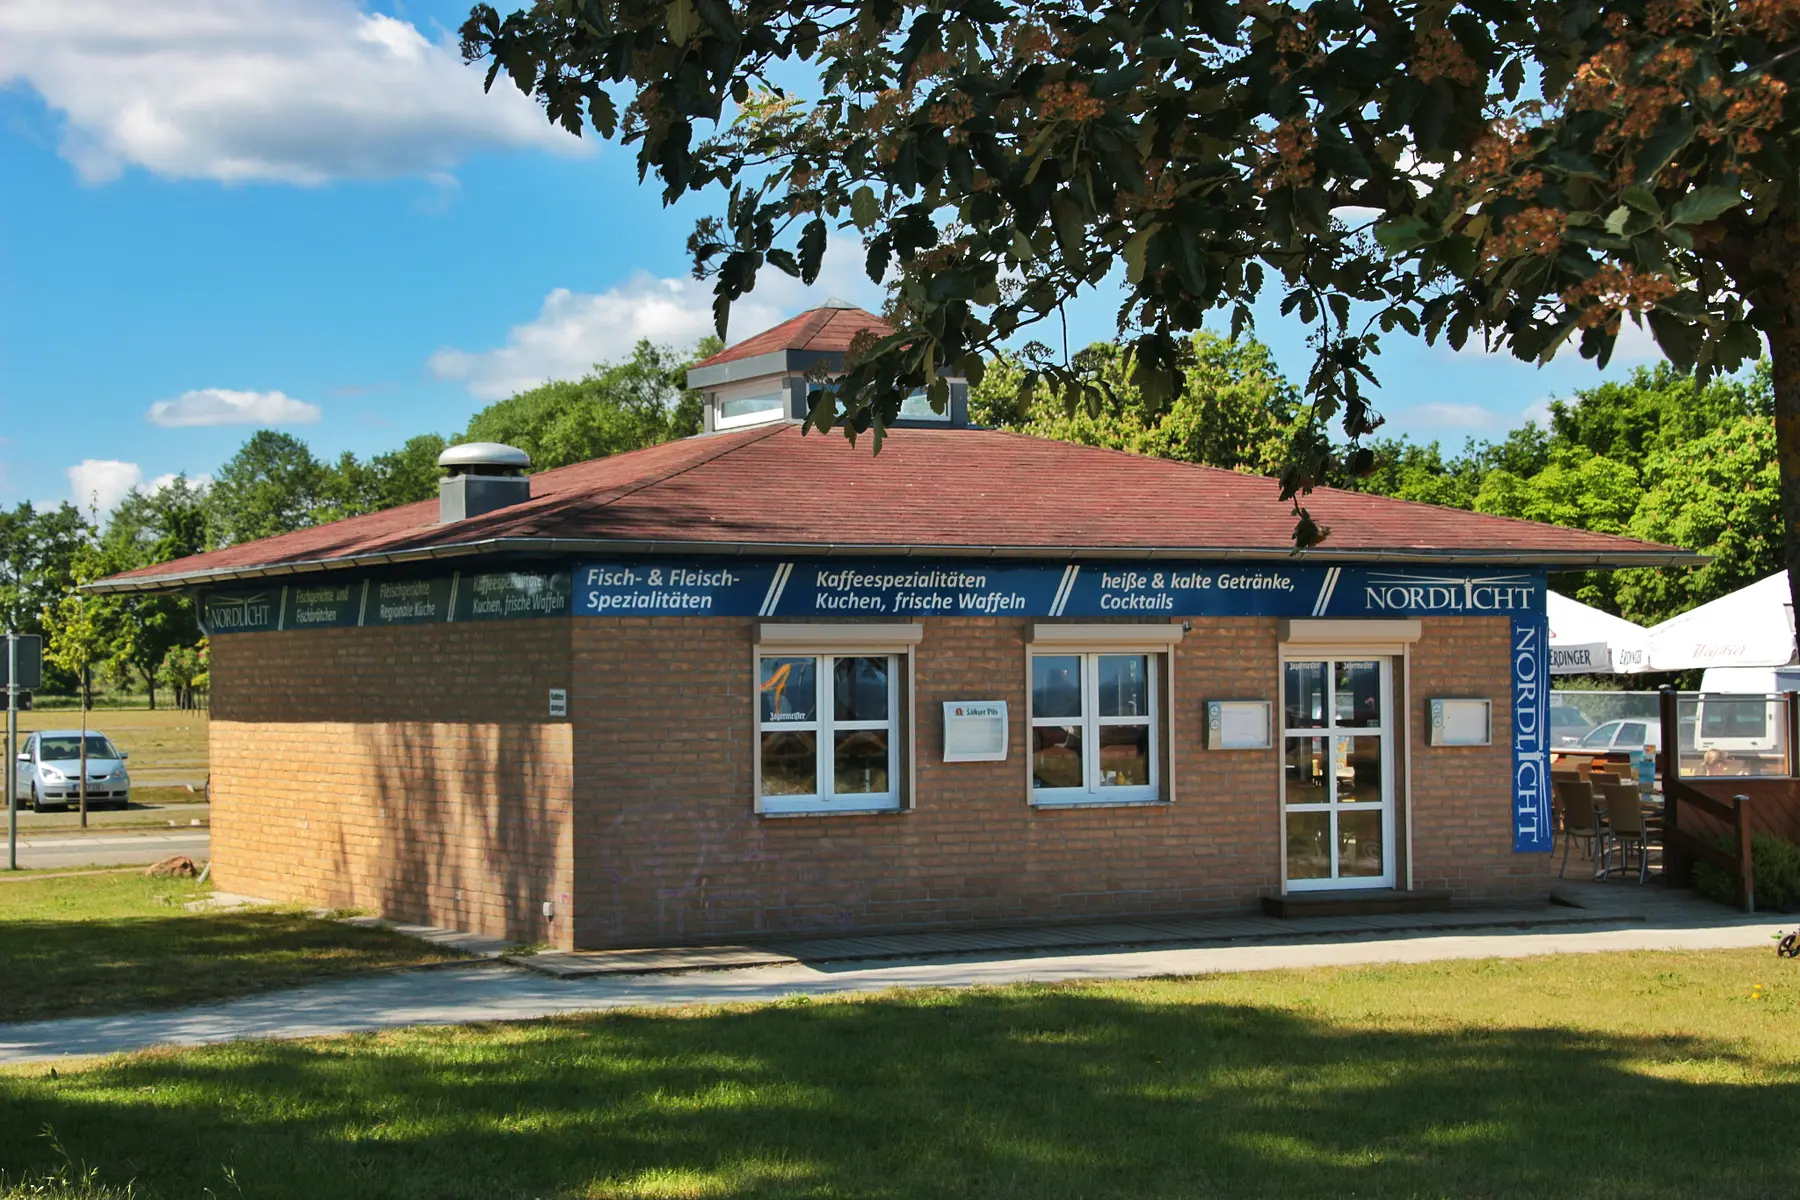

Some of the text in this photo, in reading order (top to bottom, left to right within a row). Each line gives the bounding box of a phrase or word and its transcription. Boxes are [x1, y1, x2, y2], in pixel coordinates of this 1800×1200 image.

[587, 568, 740, 587] Fisch- & Fleisch-
[816, 571, 987, 591] Kaffeespezialitäten
[1101, 572, 1295, 593] heiße & kalte Getränke,
[336, 586, 349, 601] und
[380, 581, 430, 600] Fleischgerichte
[1365, 581, 1535, 612] NORDLICHT
[380, 601, 435, 622] Regionale Küche
[473, 592, 564, 616] Kuchen, frische Waffeln
[587, 591, 712, 612] Spezialitäten
[815, 592, 1026, 613] Kuchen, frische Waffeln
[1100, 593, 1173, 610] Cocktails
[211, 605, 269, 629] NORDLICHT
[296, 608, 337, 623] Fischbrötchen
[1516, 626, 1538, 843] NORDLICHT
